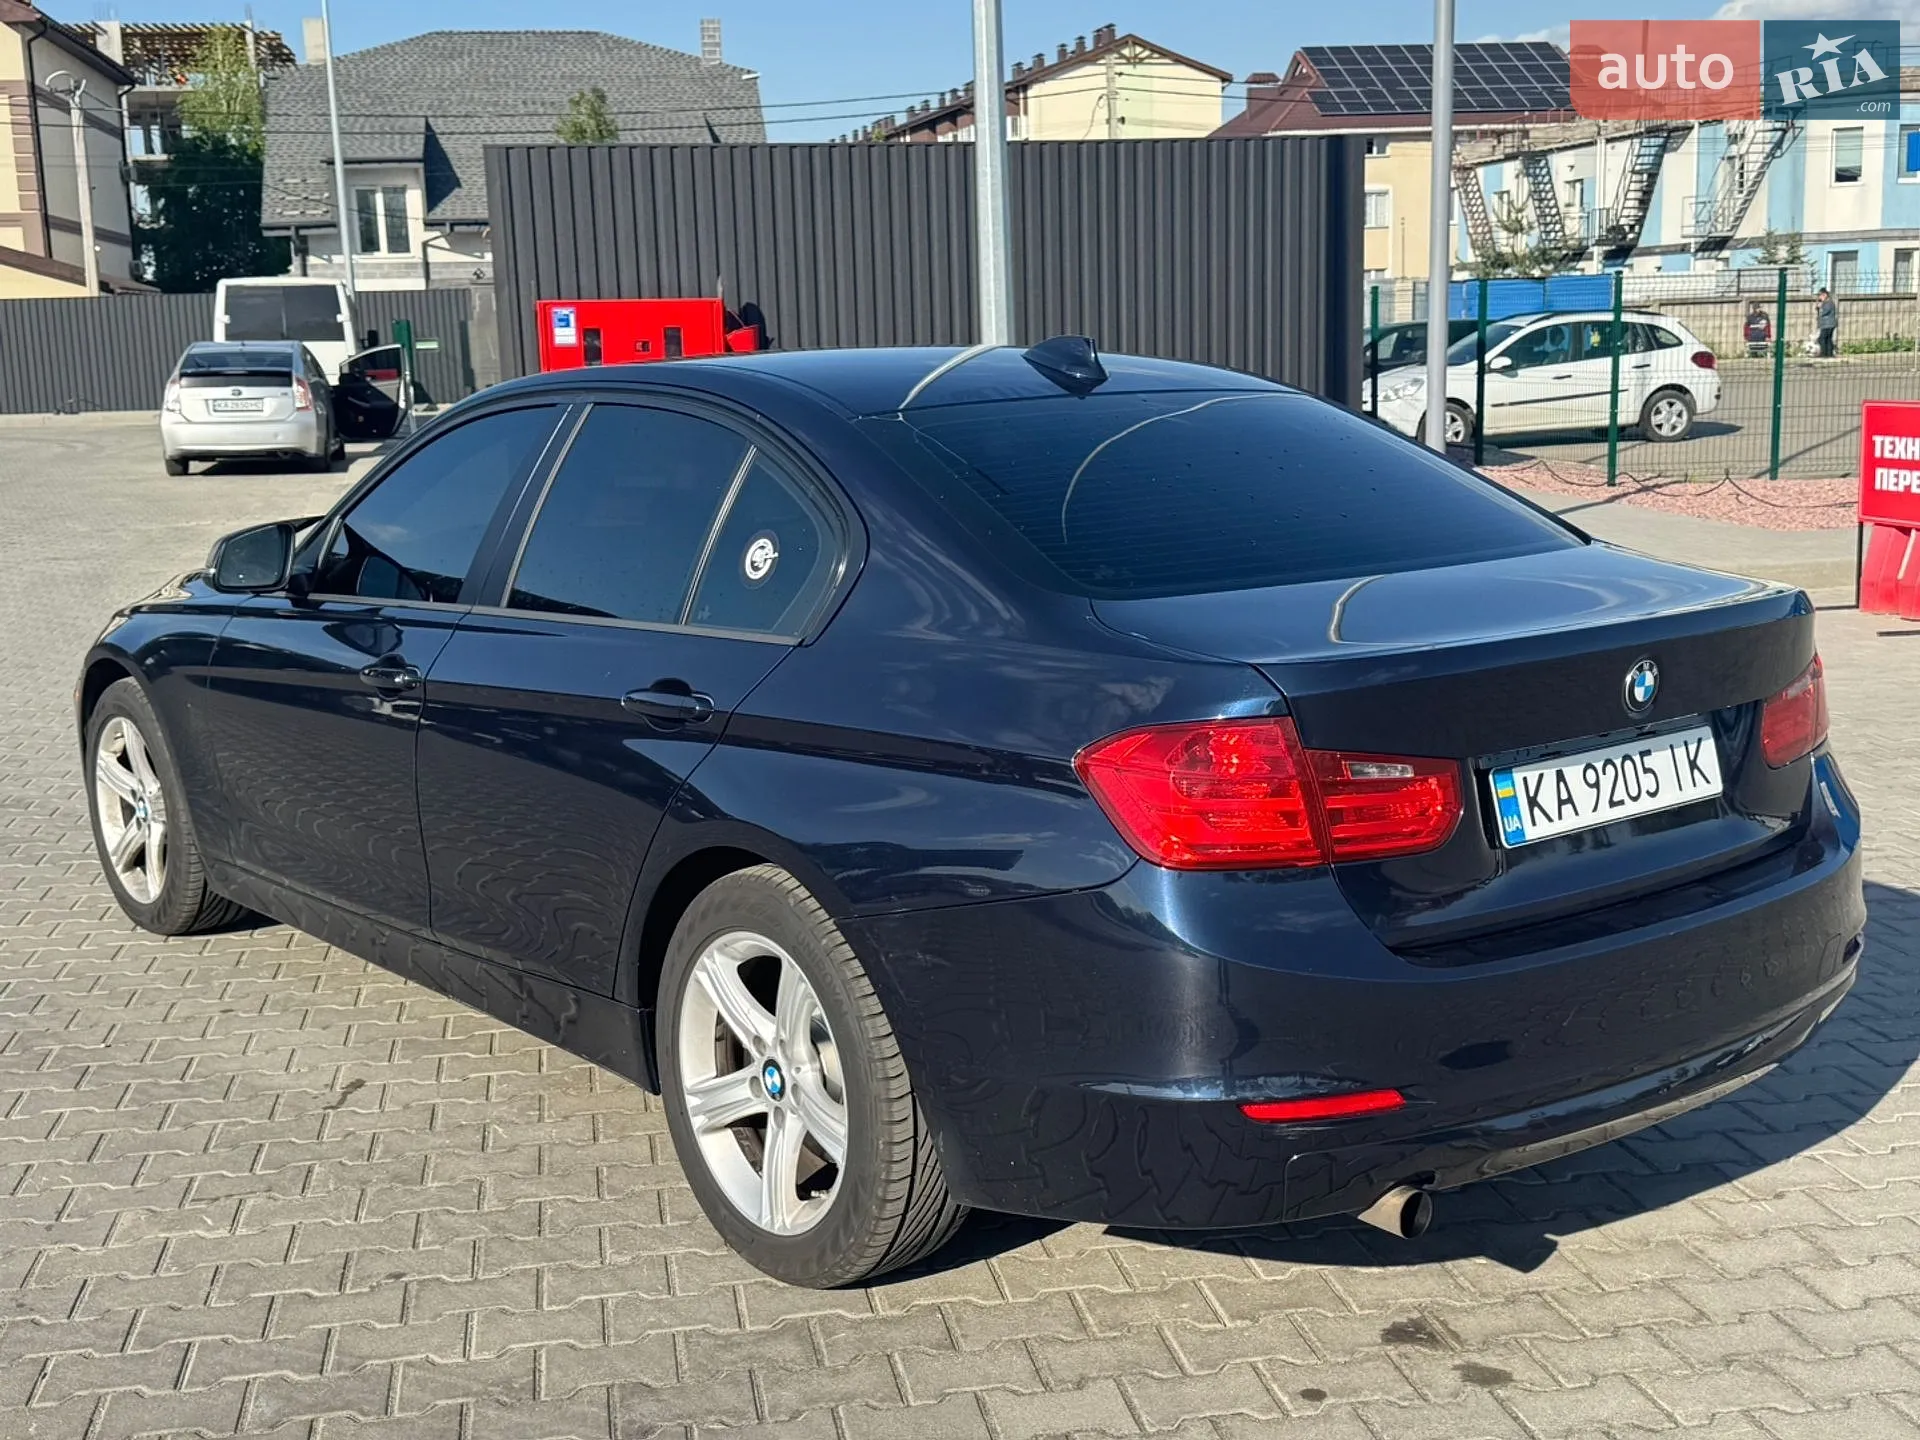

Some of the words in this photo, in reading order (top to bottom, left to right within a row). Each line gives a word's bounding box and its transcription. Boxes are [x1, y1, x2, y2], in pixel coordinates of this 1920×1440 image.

[1872, 435, 1920, 460] ТЕХН
[1875, 467, 1920, 493] ПЕРЕ
[1522, 768, 1580, 827] KA
[1582, 748, 1661, 813] 9205
[1669, 737, 1712, 791] IK
[1503, 815, 1523, 833] UA
